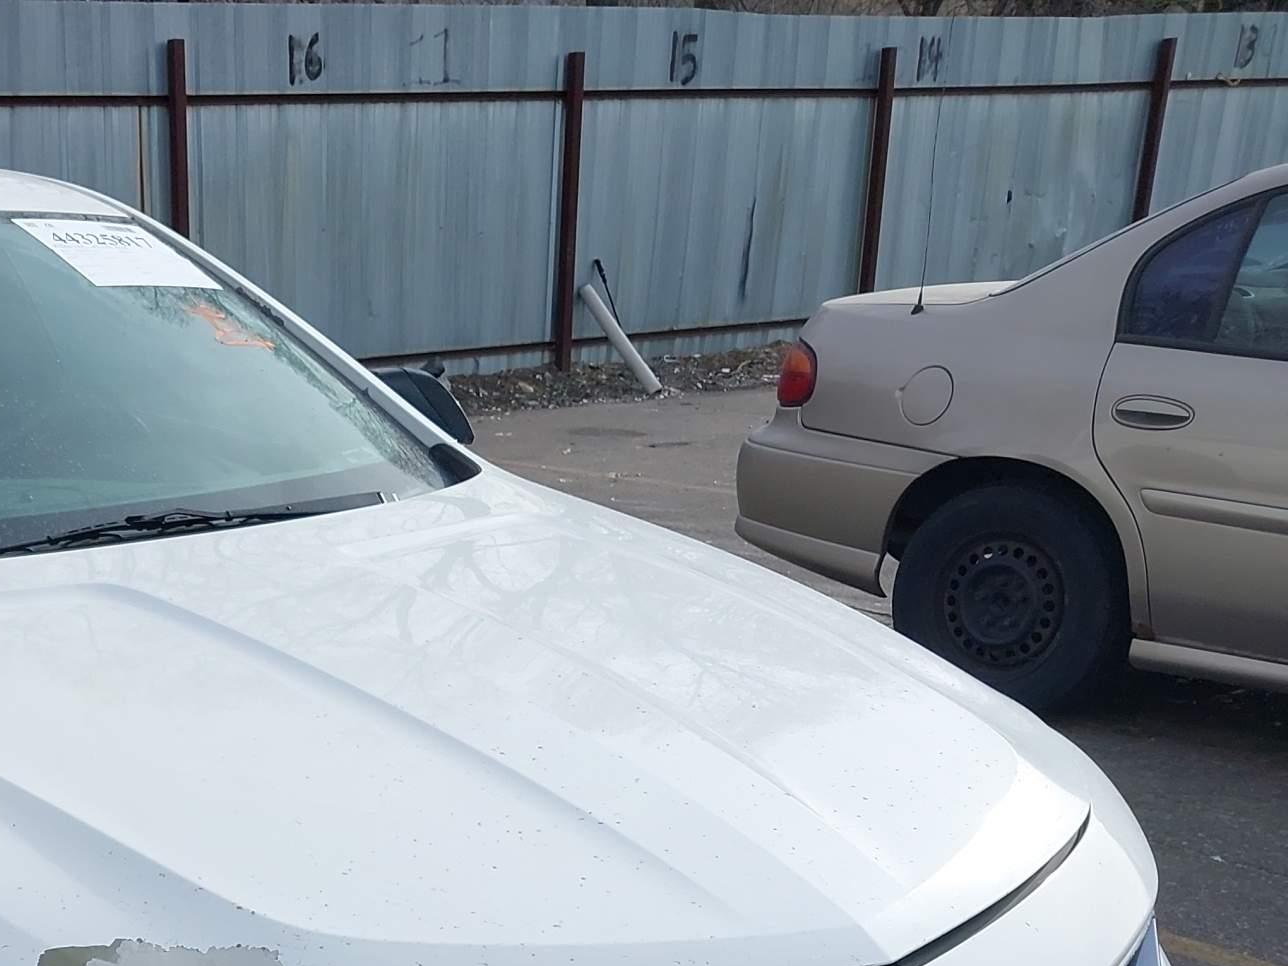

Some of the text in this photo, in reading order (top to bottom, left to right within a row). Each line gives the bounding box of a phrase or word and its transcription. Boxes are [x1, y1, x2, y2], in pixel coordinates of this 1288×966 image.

[288, 32, 323, 86] 16
[669, 30, 698, 86] 15
[915, 36, 943, 82] 14
[1233, 24, 1258, 69] 13
[52, 232, 153, 249] 44325817
